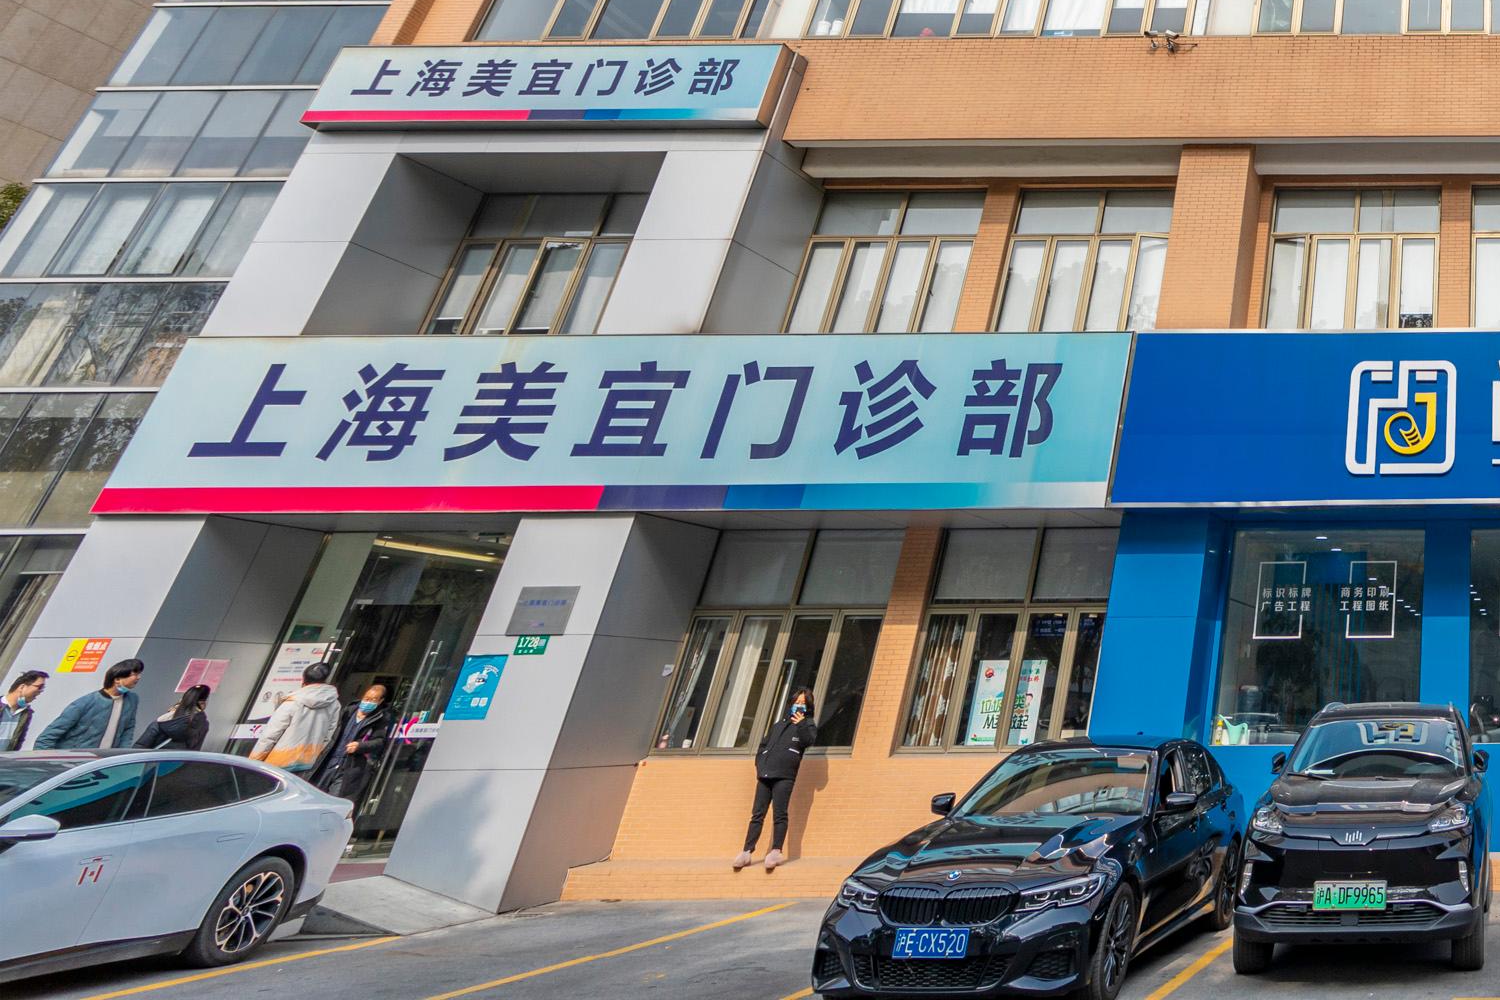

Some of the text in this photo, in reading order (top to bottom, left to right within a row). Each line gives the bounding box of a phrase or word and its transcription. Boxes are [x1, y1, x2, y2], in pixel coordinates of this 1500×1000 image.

[349, 57, 741, 98] 上海美宜门诊部
[187, 359, 1062, 462] 上海美宜门诊部
[1262, 587, 1312, 598] 标识标牌
[1340, 587, 1390, 598] 商务印刷
[1261, 600, 1311, 612] 广告工程
[1339, 600, 1389, 612] 工程图纸
